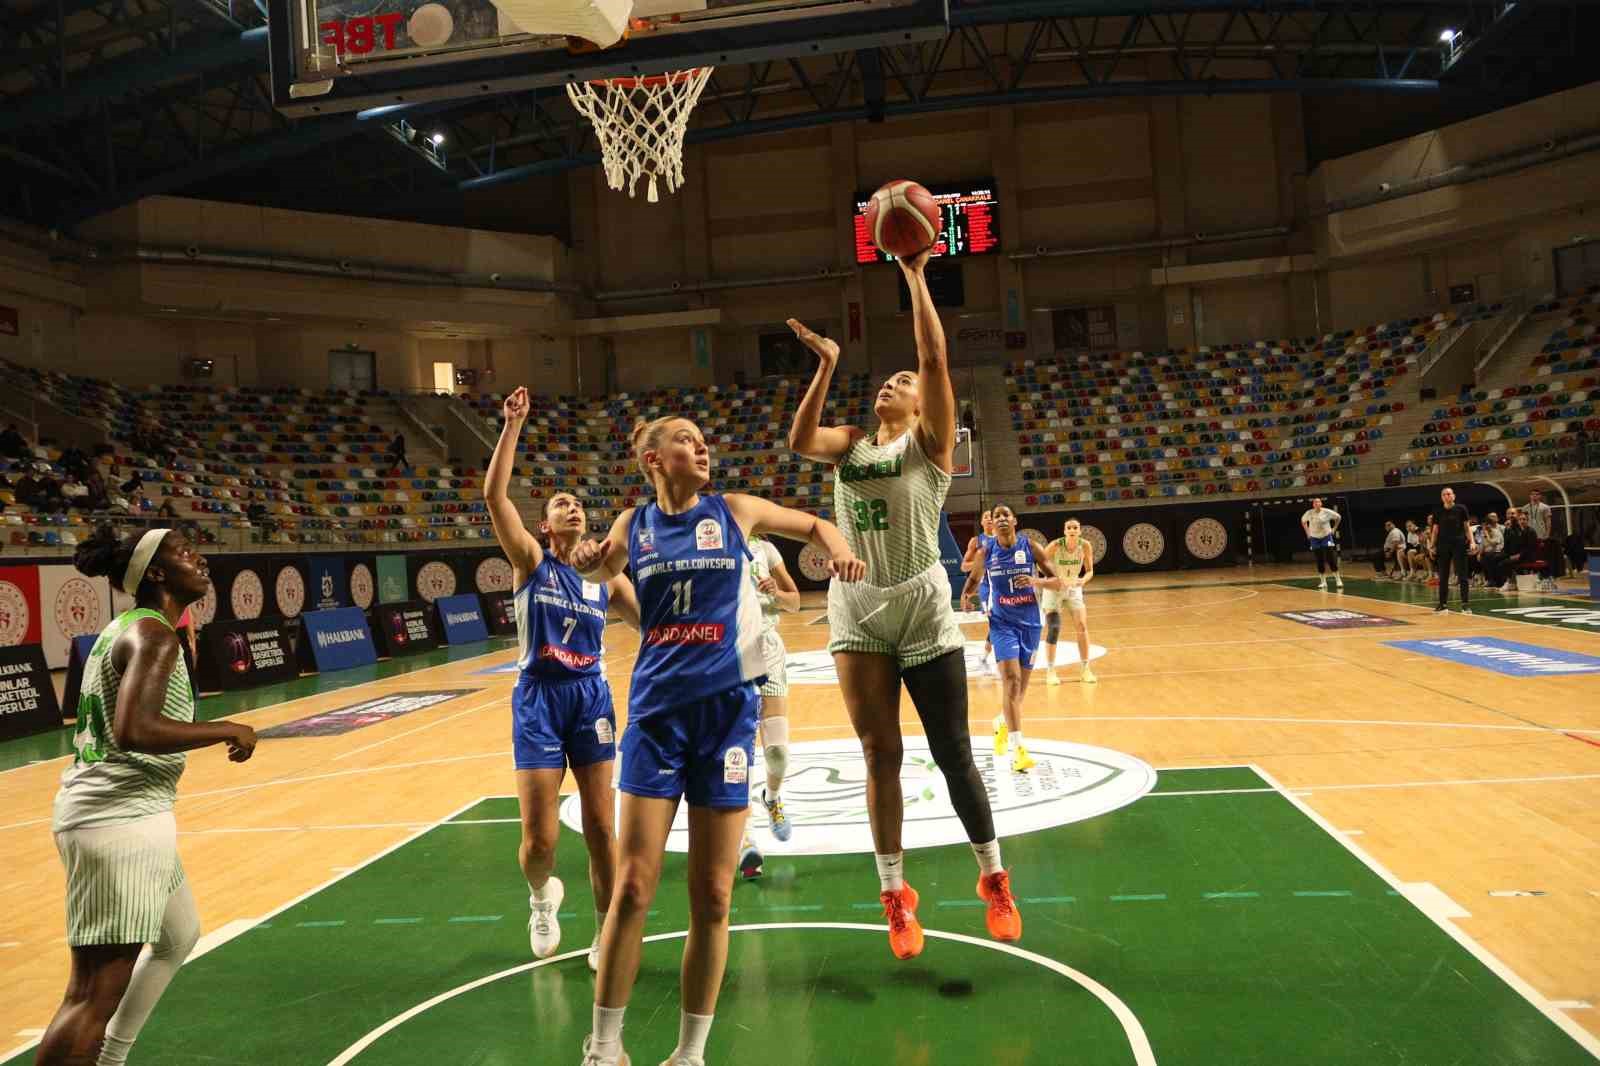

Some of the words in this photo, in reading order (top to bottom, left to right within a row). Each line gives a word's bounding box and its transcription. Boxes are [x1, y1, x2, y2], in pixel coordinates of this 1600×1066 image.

[853, 498, 888, 532] 32
[672, 579, 693, 616] 11
[327, 628, 365, 644] HALKBANK
[562, 616, 578, 646] 7
